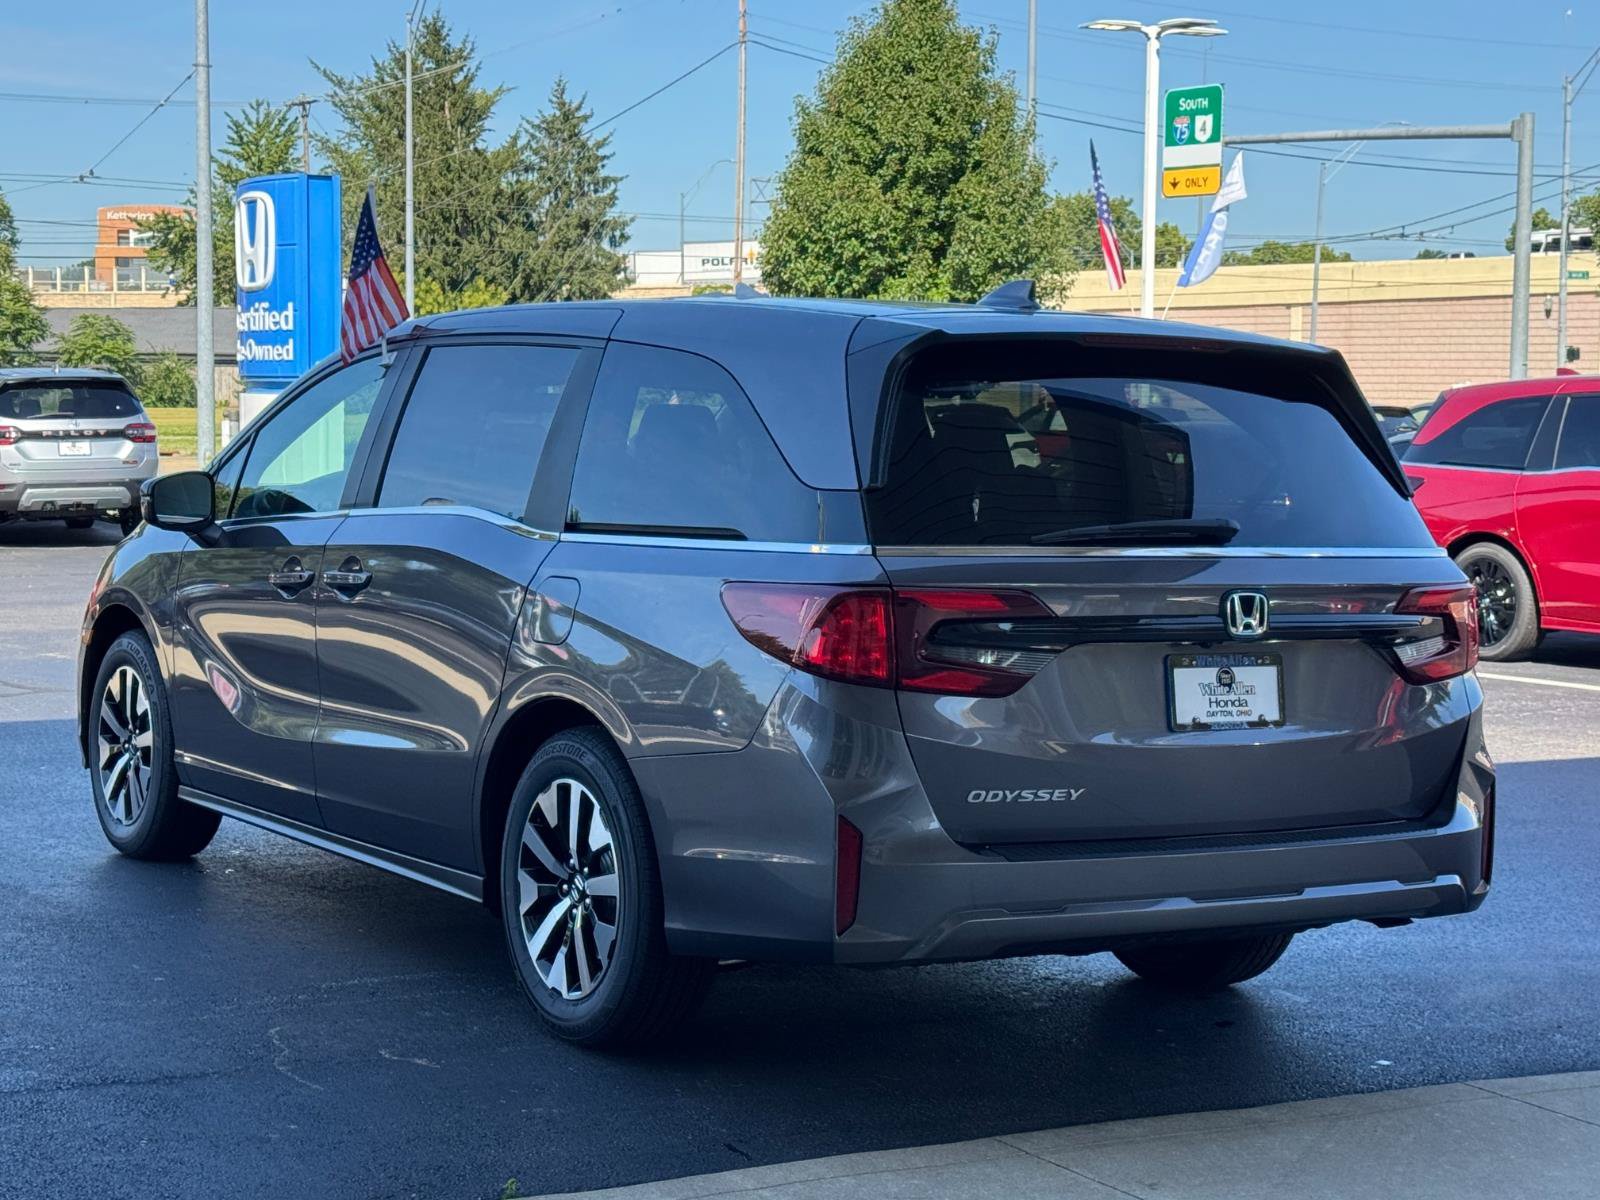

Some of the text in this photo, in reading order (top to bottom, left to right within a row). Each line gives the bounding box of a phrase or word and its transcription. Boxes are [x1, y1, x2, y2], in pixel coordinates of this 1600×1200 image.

[1178, 97, 1209, 111] SOUTH
[1174, 123, 1190, 139] 75
[1199, 119, 1207, 135] 4
[1184, 176, 1209, 189] ONLY
[41, 429, 108, 437] PILOT
[1208, 696, 1249, 709] Honda
[1235, 709, 1253, 717] OHIO
[967, 788, 1087, 803] ODYSSEY
